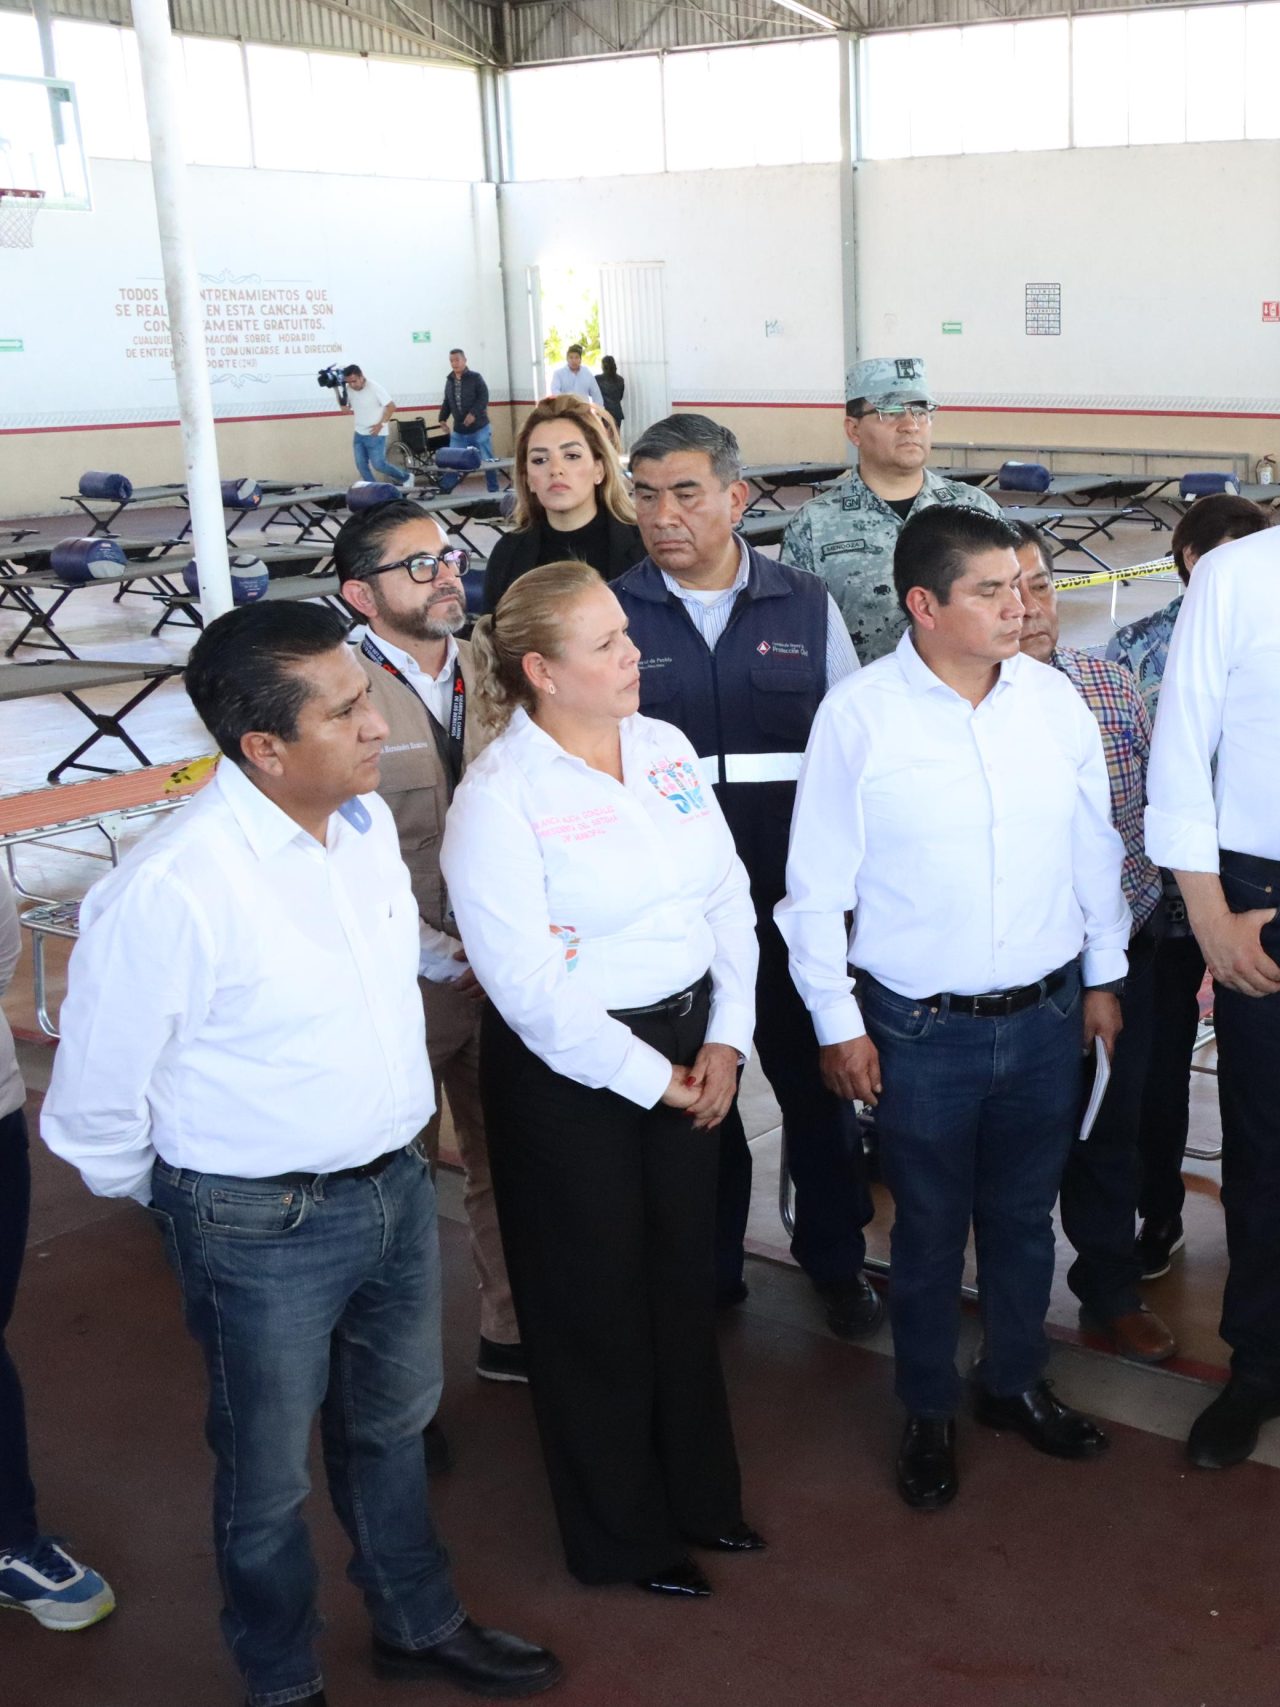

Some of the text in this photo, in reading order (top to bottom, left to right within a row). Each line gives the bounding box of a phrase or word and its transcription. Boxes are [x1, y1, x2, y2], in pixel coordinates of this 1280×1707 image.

[119, 288, 327, 302] TODOS NTRENAMIENTOS QUE
[115, 303, 334, 316] SE REAL EN ESTA CANCHA SON
[133, 333, 316, 345] CUALQUIE MACIÓN SOBRE HORARIO
[126, 348, 138, 358] DE
[221, 345, 280, 356] COMUNICARSE
[284, 346, 290, 354] A
[292, 345, 302, 354] LA
[845, 499, 858, 507] GN
[827, 542, 860, 552] MENDOZA
[772, 646, 800, 655] Protección
